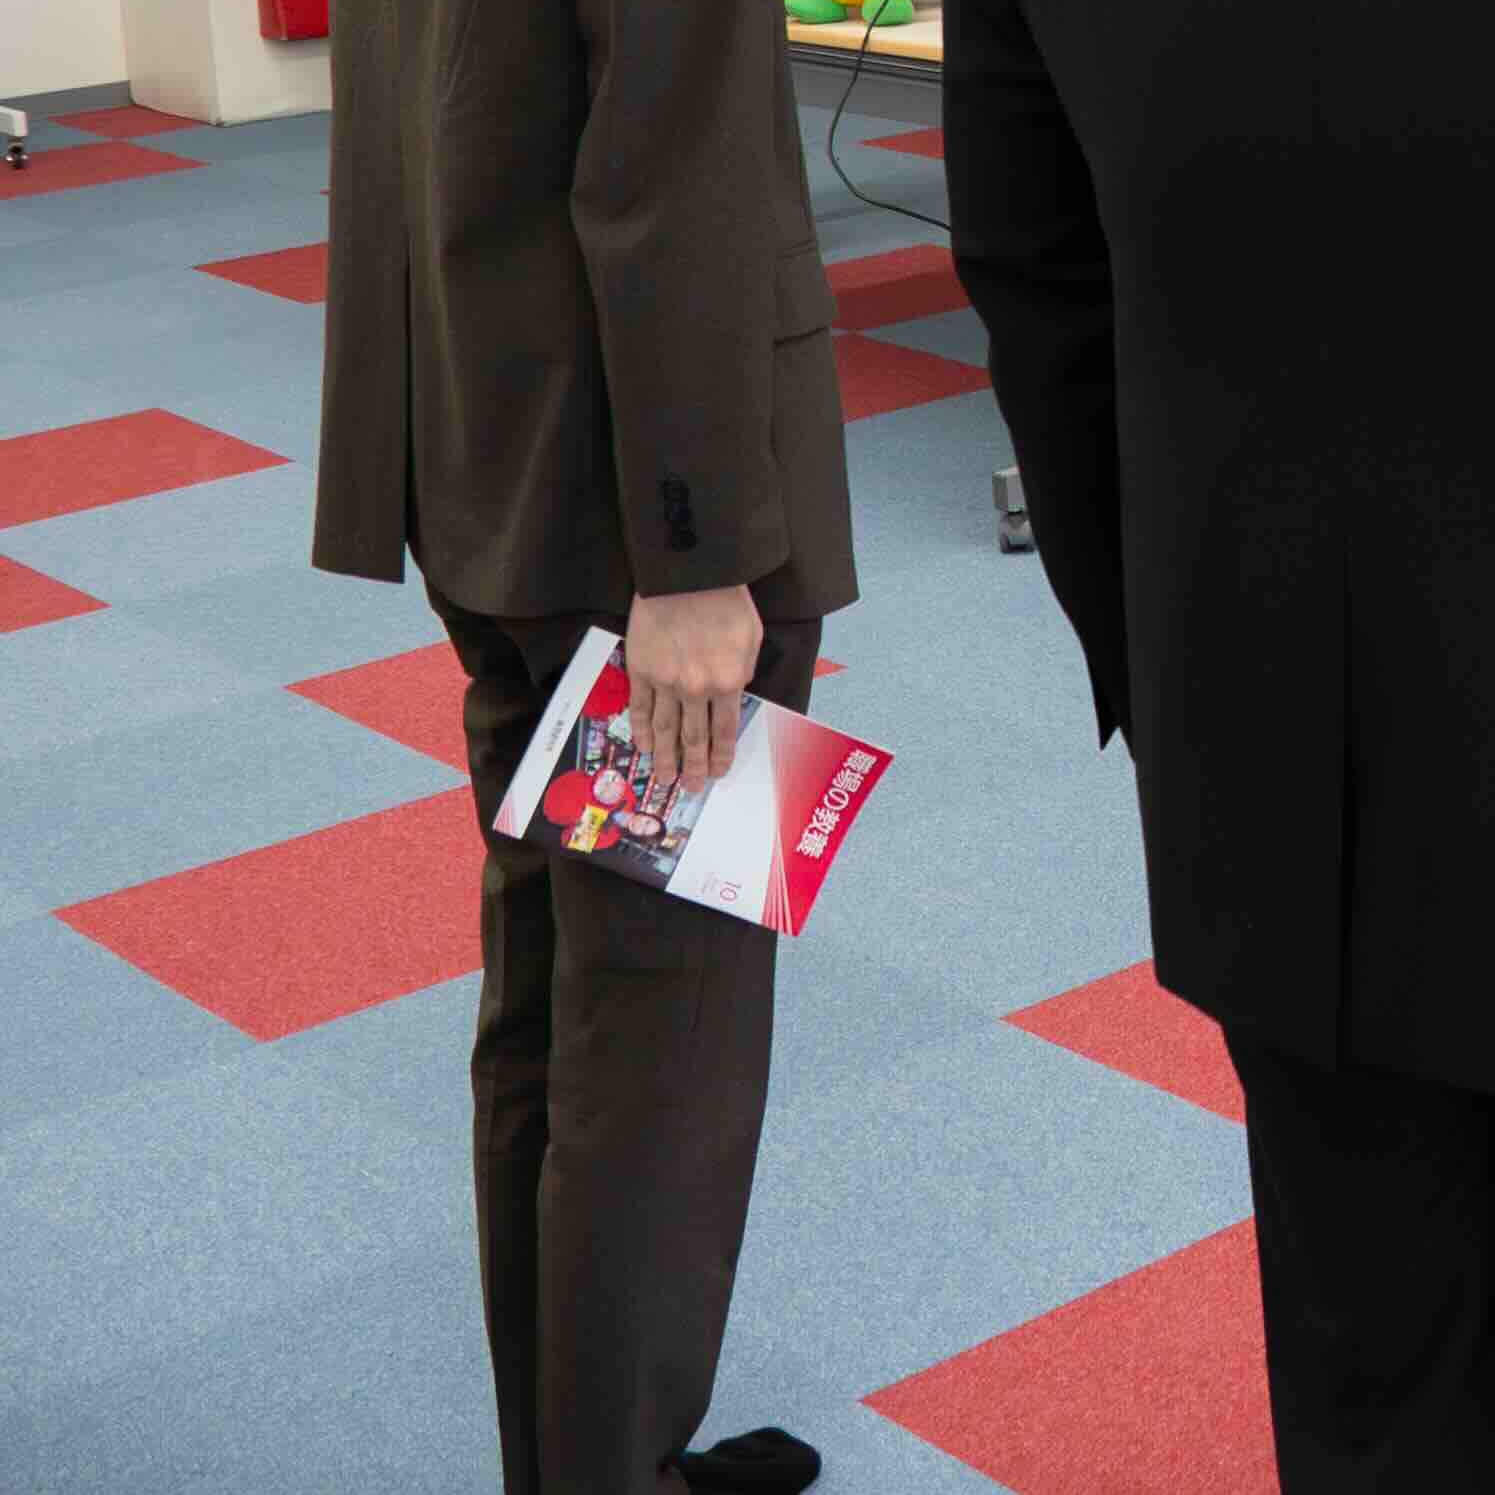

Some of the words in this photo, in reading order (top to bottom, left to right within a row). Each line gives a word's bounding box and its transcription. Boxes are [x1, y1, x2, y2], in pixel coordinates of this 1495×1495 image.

[796, 750, 878, 859] 職場の教養
